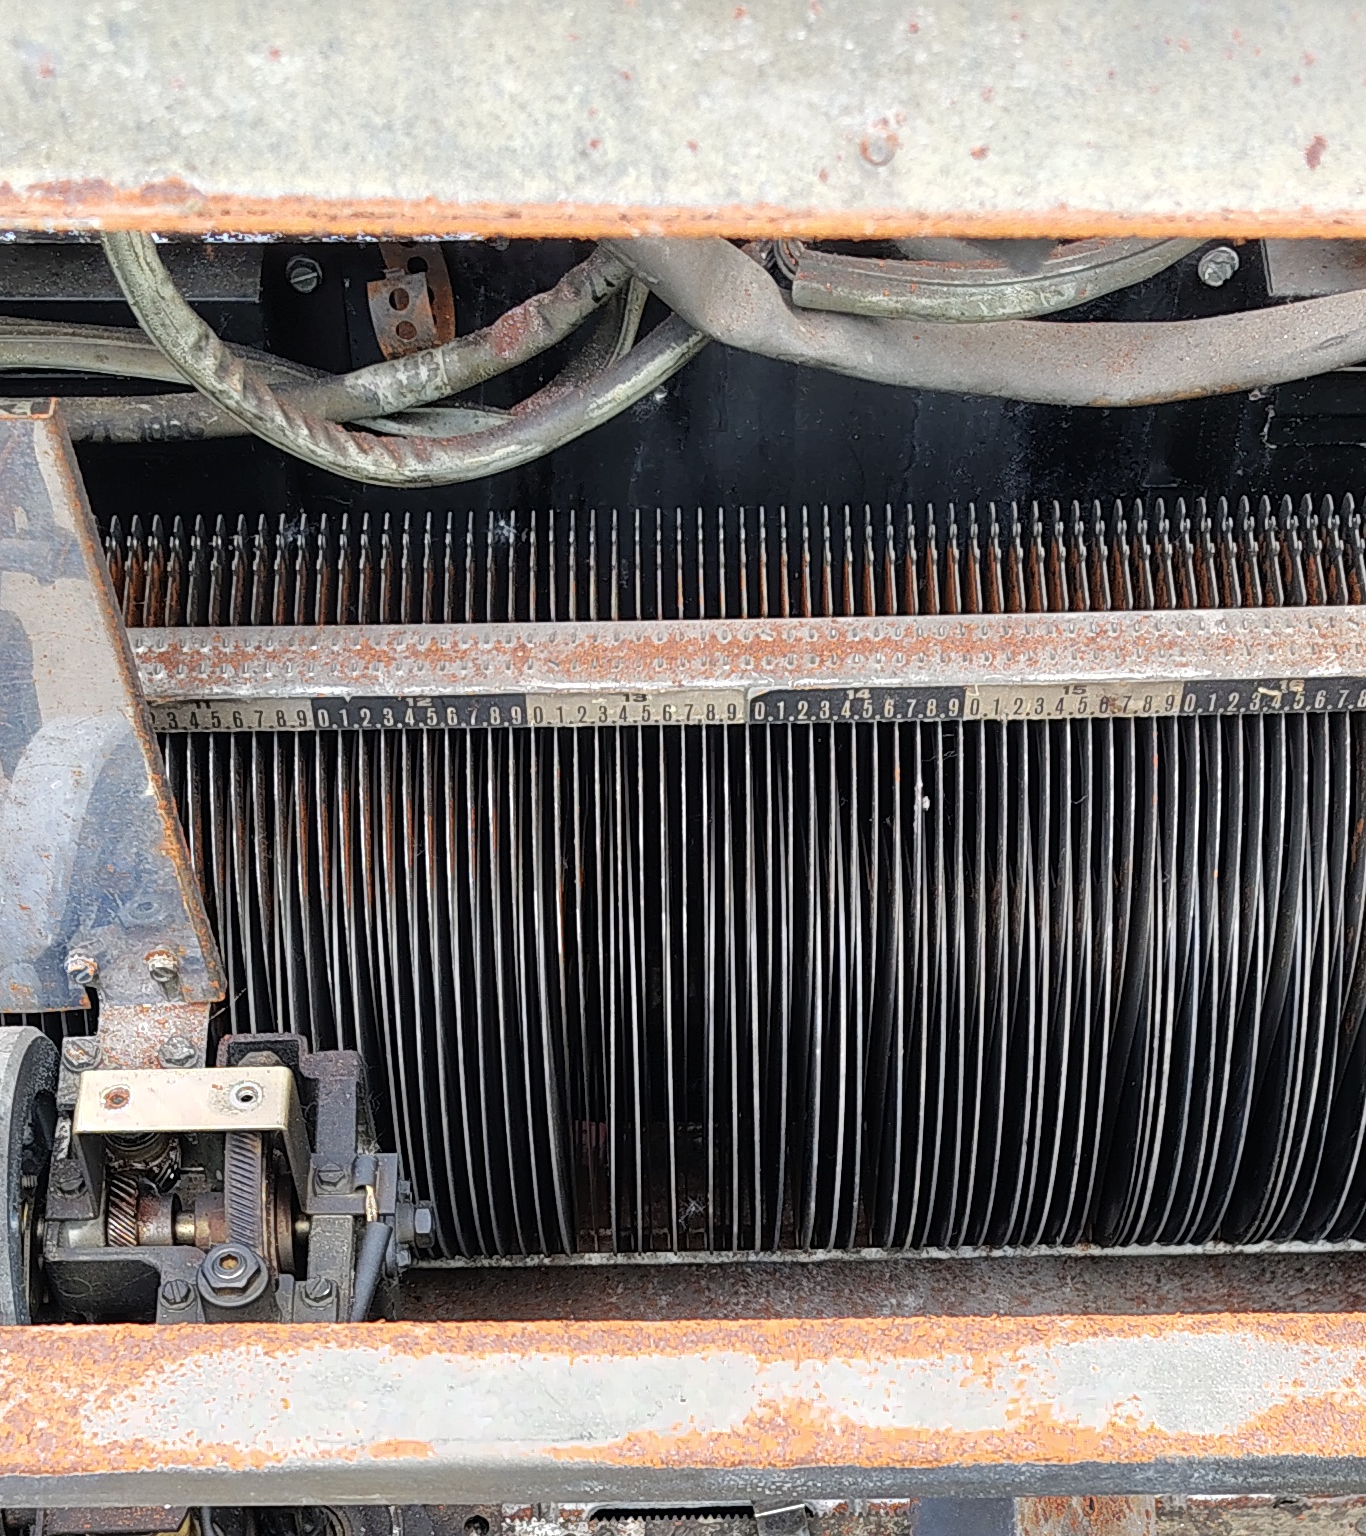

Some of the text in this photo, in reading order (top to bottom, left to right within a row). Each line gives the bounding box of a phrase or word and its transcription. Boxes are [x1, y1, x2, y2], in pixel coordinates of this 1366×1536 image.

[846, 689, 871, 699] 14
[1063, 685, 1087, 695] 15
[405, 697, 433, 707] 12
[623, 693, 647, 703] 13
